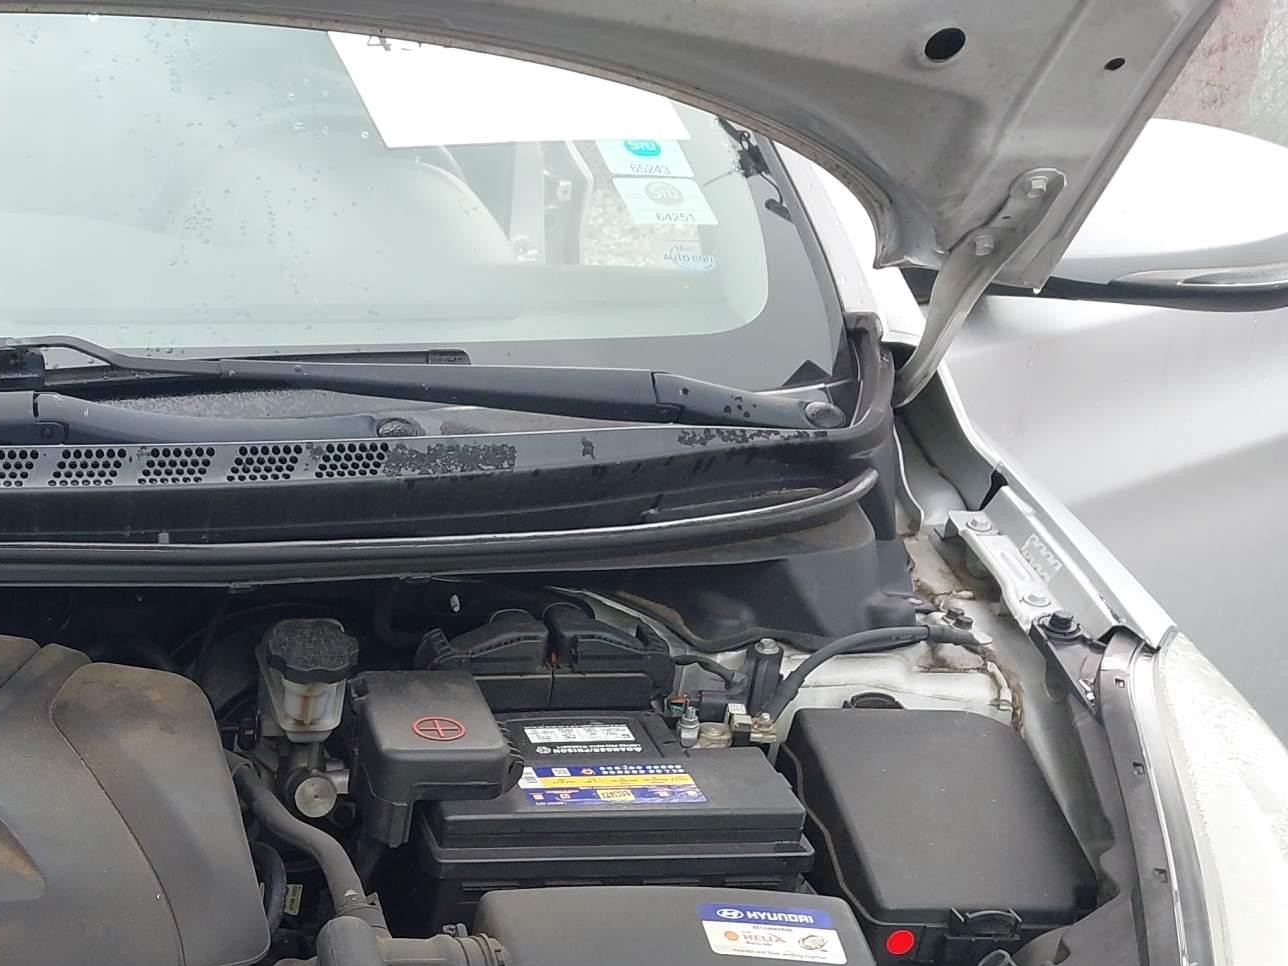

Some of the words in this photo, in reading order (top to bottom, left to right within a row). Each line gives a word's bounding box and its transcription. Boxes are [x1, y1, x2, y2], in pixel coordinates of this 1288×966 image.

[630, 163, 671, 175] 65243
[655, 212, 695, 222] 64251
[746, 910, 814, 924] HYUNDAI
